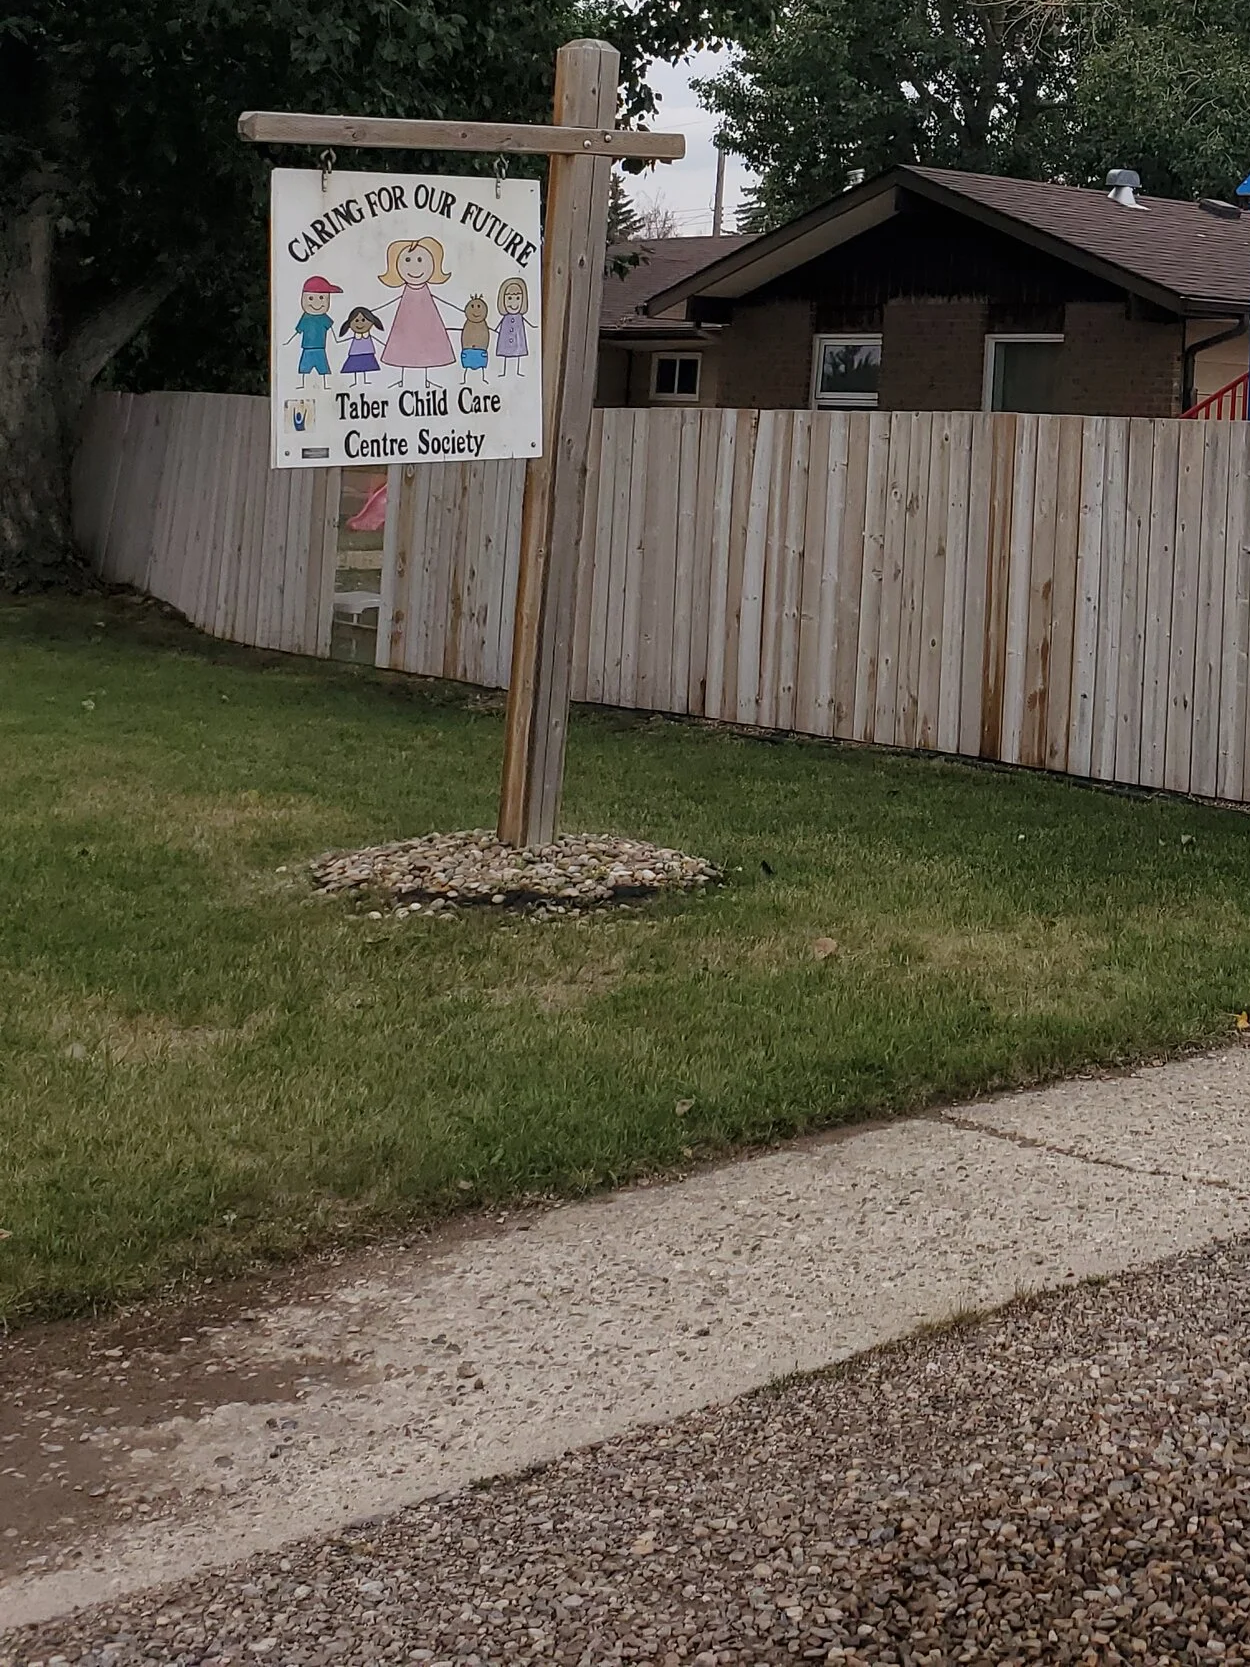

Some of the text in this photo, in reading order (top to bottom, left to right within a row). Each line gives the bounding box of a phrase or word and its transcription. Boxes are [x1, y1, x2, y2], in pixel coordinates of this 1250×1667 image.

[287, 184, 537, 268] CARING FOR OUR FUTURE
[335, 387, 501, 420] Taber Child Care
[344, 428, 485, 458] Centre Society
